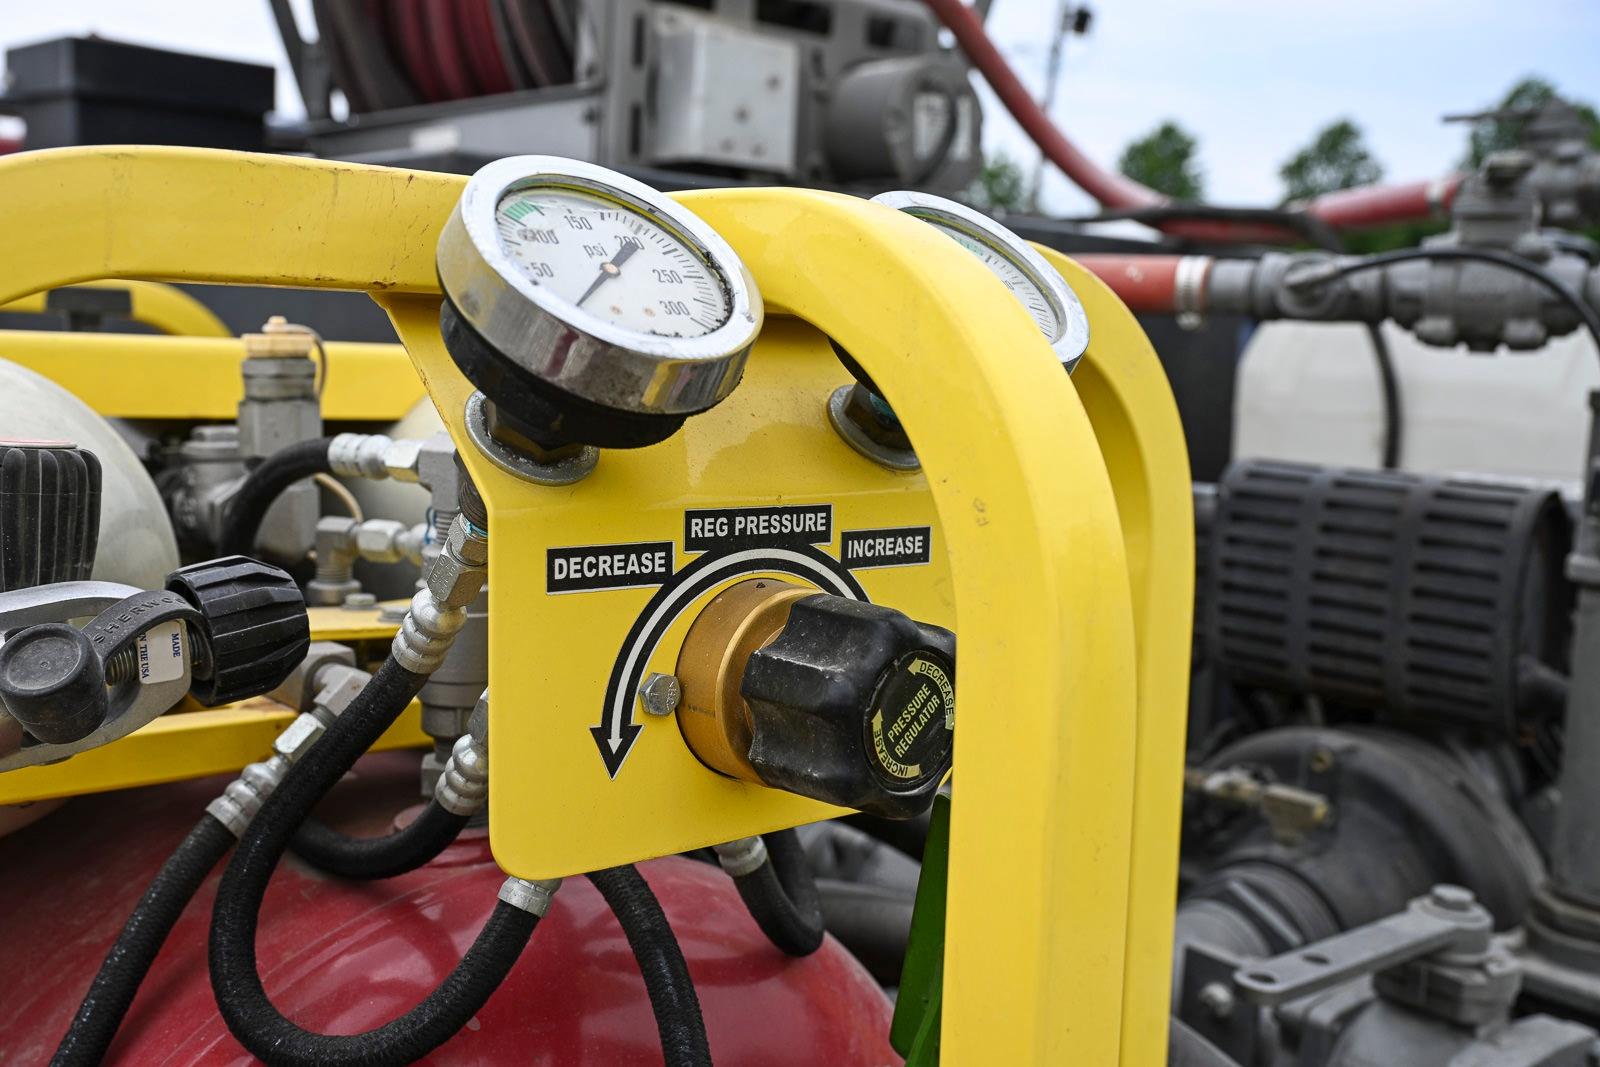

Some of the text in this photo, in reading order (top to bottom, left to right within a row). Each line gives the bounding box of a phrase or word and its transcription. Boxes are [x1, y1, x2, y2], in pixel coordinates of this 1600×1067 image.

[564, 215, 593, 230] 150
[582, 243, 608, 260] psi
[530, 262, 554, 278] 50
[652, 269, 683, 284] 250
[659, 300, 691, 316] 300
[691, 512, 827, 538] REG PRESSURE
[847, 536, 923, 559] INCREASE
[553, 551, 666, 580] DECREASE
[140, 644, 148, 662] THE
[171, 633, 181, 658] MADE
[141, 663, 150, 679] USA
[919, 662, 954, 715] DECREASE
[887, 683, 931, 743] PRESSURE
[894, 694, 941, 758] REGULATOR
[874, 728, 909, 777] INCREASE
